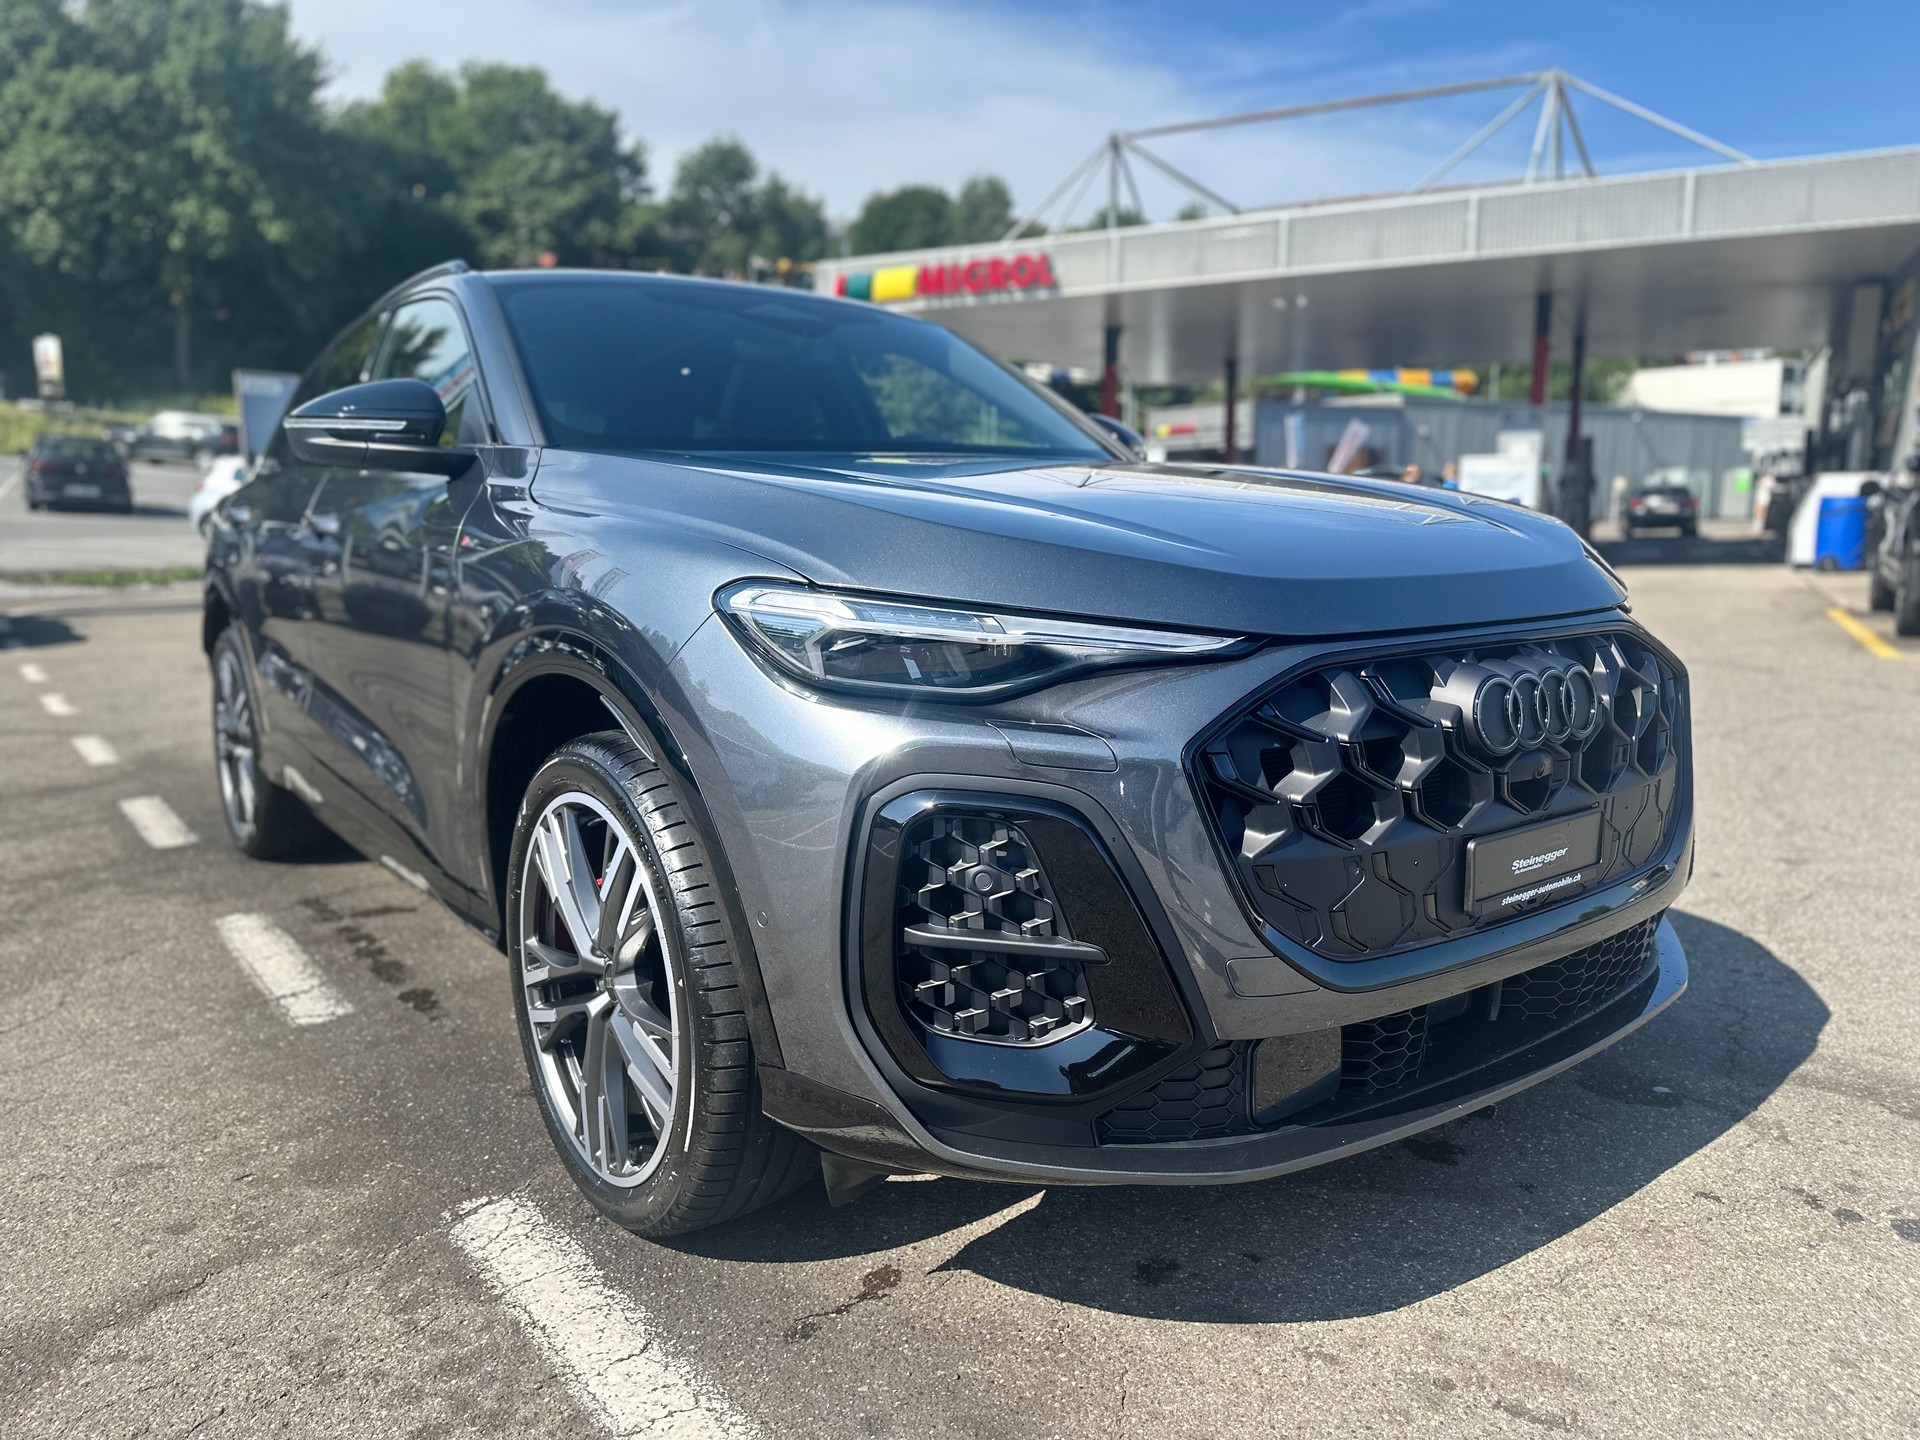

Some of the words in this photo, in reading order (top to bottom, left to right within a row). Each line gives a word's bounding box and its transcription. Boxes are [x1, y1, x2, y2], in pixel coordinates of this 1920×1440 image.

[917, 251, 1056, 296] MIGROL
[1511, 847, 1568, 869] Steinegger
[1513, 863, 1543, 875] Automobile
[1501, 873, 1581, 905] steinegger-automobile.ch
